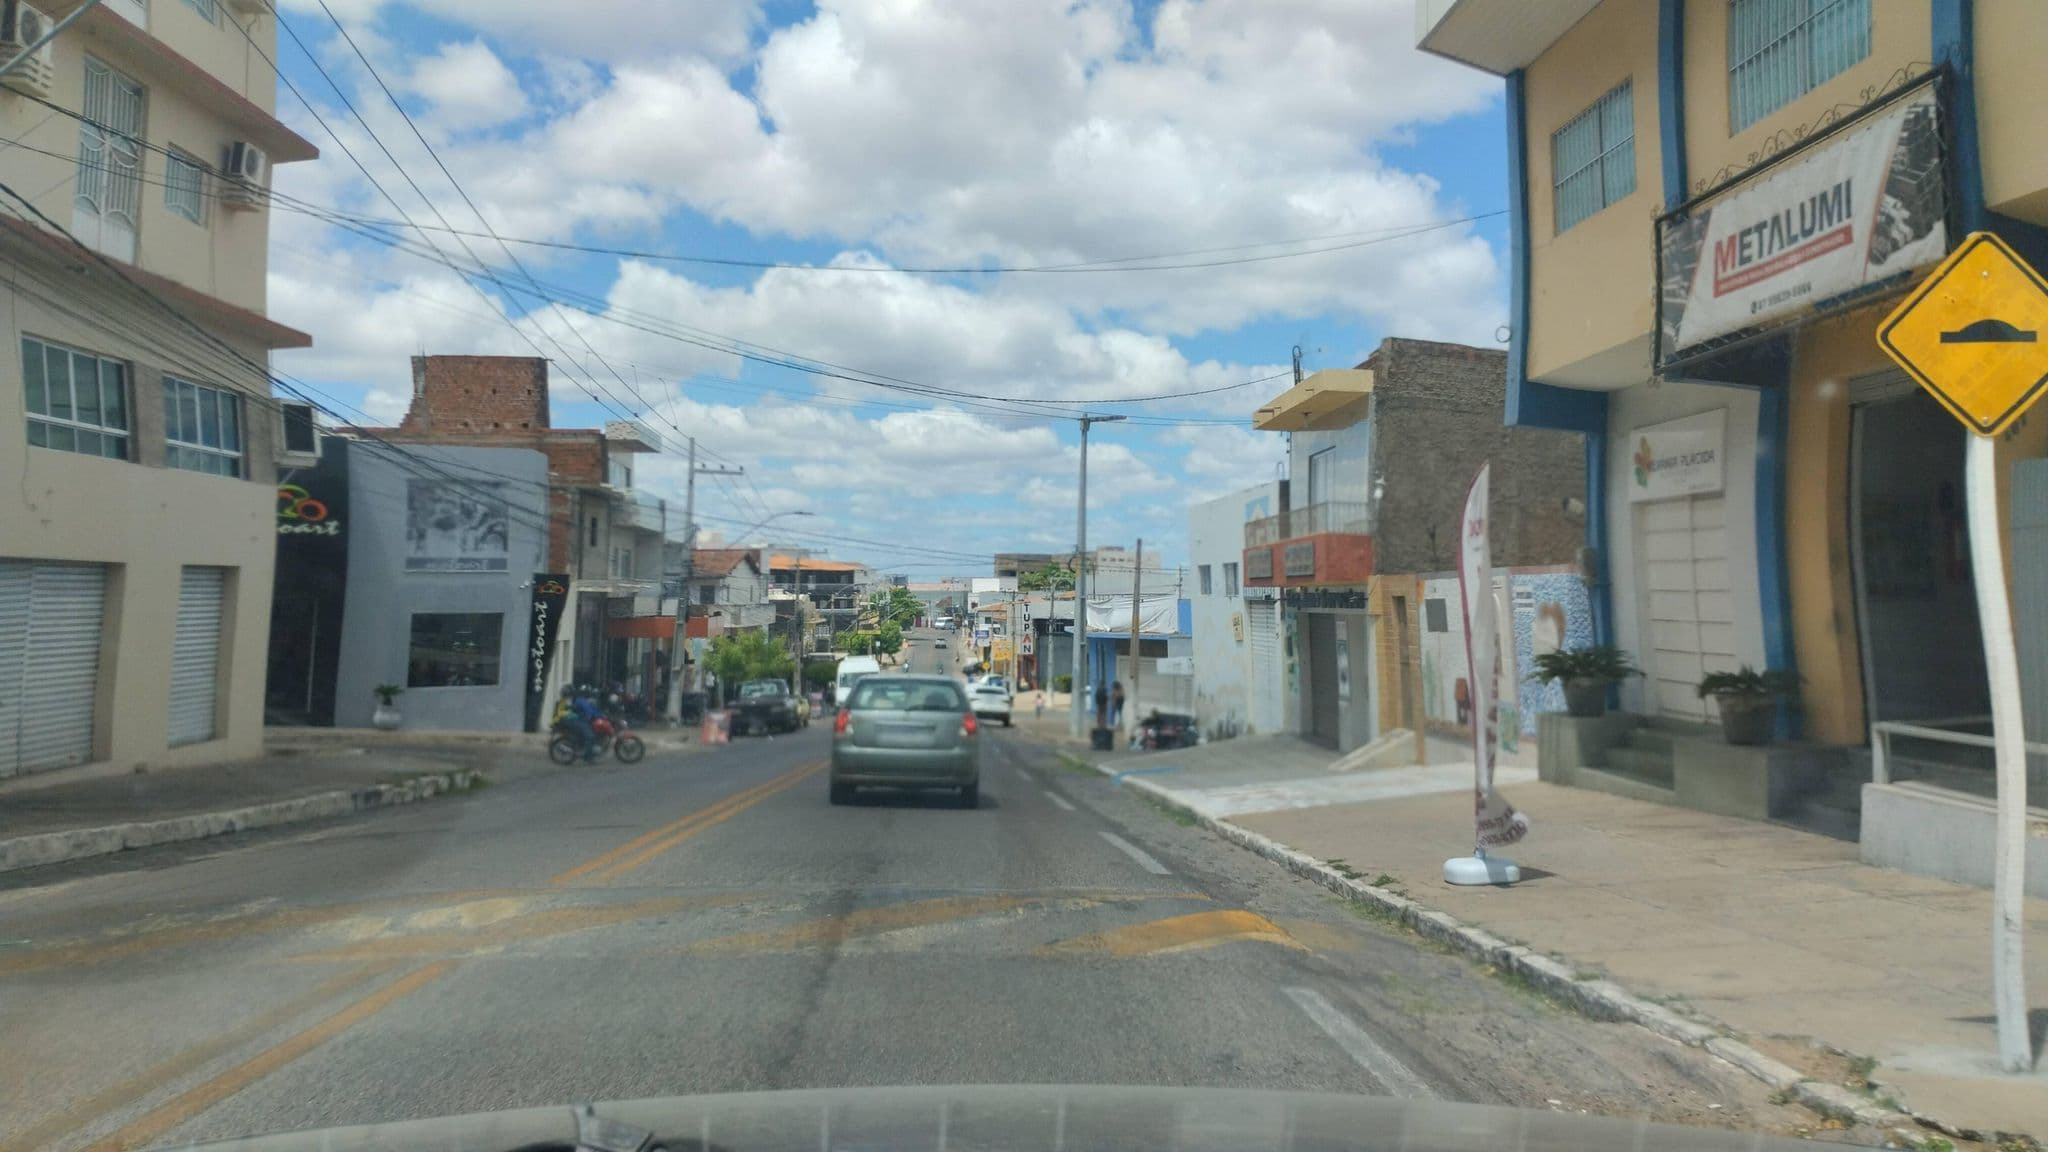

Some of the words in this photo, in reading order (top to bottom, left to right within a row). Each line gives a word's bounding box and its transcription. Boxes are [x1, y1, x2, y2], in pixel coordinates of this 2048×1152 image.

[1714, 179, 1853, 274] METALUMI
[531, 601, 548, 693] motoart
[1023, 604, 1032, 652] TUPAN
